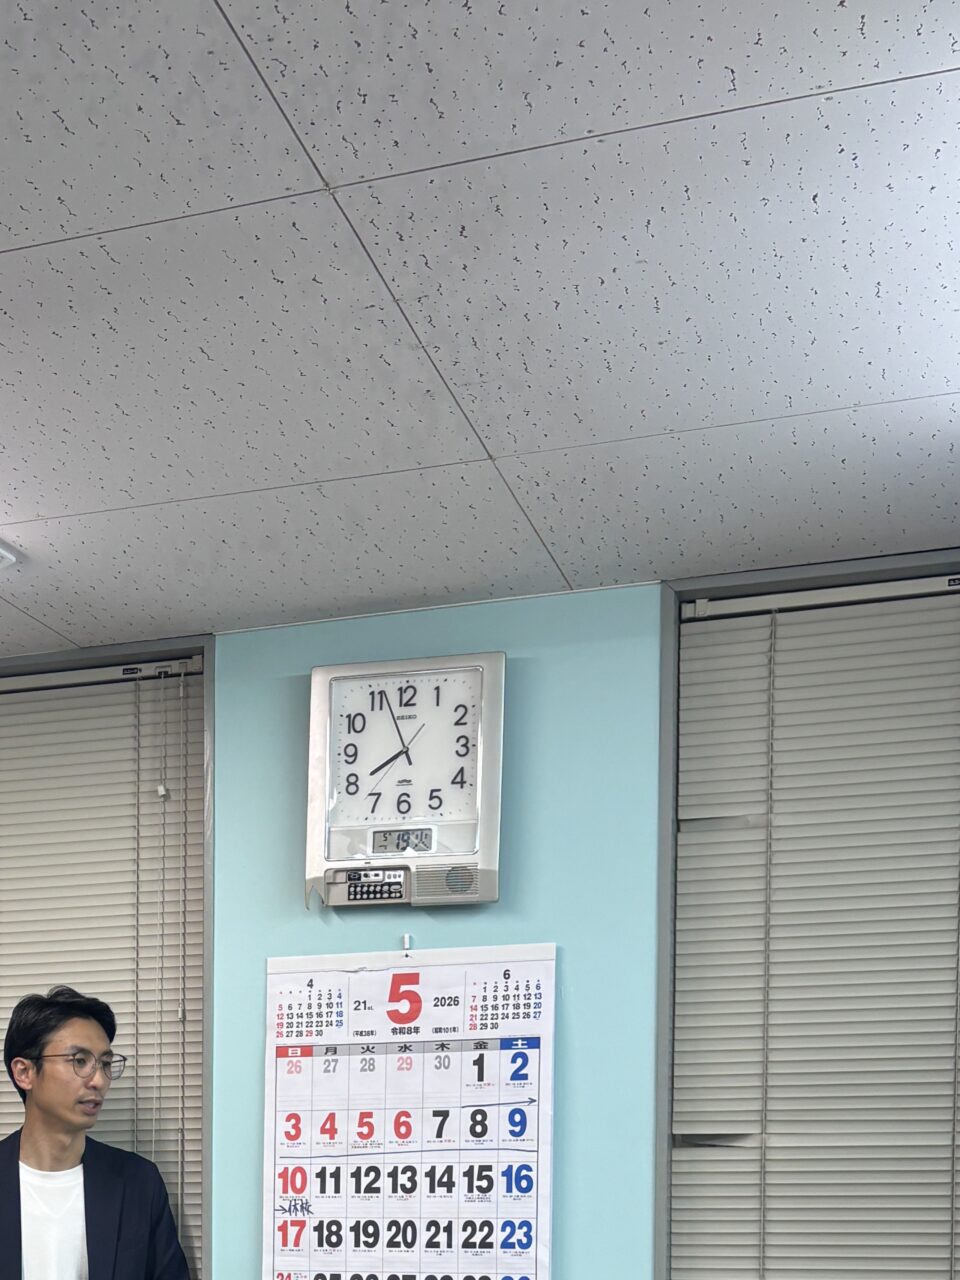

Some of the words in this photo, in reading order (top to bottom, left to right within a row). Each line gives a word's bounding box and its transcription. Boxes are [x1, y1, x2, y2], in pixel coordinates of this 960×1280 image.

[398, 686, 417, 707] 12
[434, 686, 440, 706] 1
[346, 713, 366, 734] 10
[454, 705, 468, 726] 2
[344, 743, 357, 765] 9
[456, 736, 469, 757] 3
[346, 773, 359, 795] 8
[451, 767, 466, 789] 4
[368, 793, 381, 814] 7
[397, 793, 411, 814] 6
[428, 789, 442, 810] 5
[307, 979, 314, 989] 4
[503, 969, 510, 980] 6
[386, 973, 422, 1024] 5
[433, 996, 459, 1007] 2026
[288, 1048, 300, 1056] 日
[325, 1047, 337, 1055] 月
[361, 1046, 375, 1054] 火
[398, 1044, 412, 1053] 水
[435, 1043, 450, 1051] 木
[473, 1041, 488, 1049] 金
[512, 1039, 528, 1048] 土
[287, 1060, 302, 1074] 26
[323, 1059, 338, 1073] 27
[360, 1058, 375, 1072] 28
[397, 1056, 413, 1071] 29
[434, 1055, 450, 1070] 30
[473, 1053, 484, 1082] 1
[510, 1052, 529, 1081] 2
[284, 1113, 301, 1141] 3
[320, 1113, 338, 1140] 4
[357, 1112, 374, 1140] 5
[394, 1111, 412, 1140] 6
[432, 1110, 449, 1138] 7
[469, 1109, 488, 1138] 8
[508, 1108, 527, 1137] 9
[278, 1167, 307, 1195] 10
[315, 1167, 340, 1194] 11
[351, 1166, 381, 1194] 12
[387, 1165, 417, 1194] 13
[424, 1165, 455, 1193] 14
[463, 1165, 494, 1193] 15
[501, 1164, 533, 1193] 16
[277, 1220, 306, 1247] 17
[313, 1220, 343, 1248] 18
[350, 1220, 380, 1248] 19
[386, 1220, 417, 1249] 20
[425, 1220, 452, 1248] 21
[461, 1220, 494, 1248] 22
[500, 1220, 532, 1249] 23
